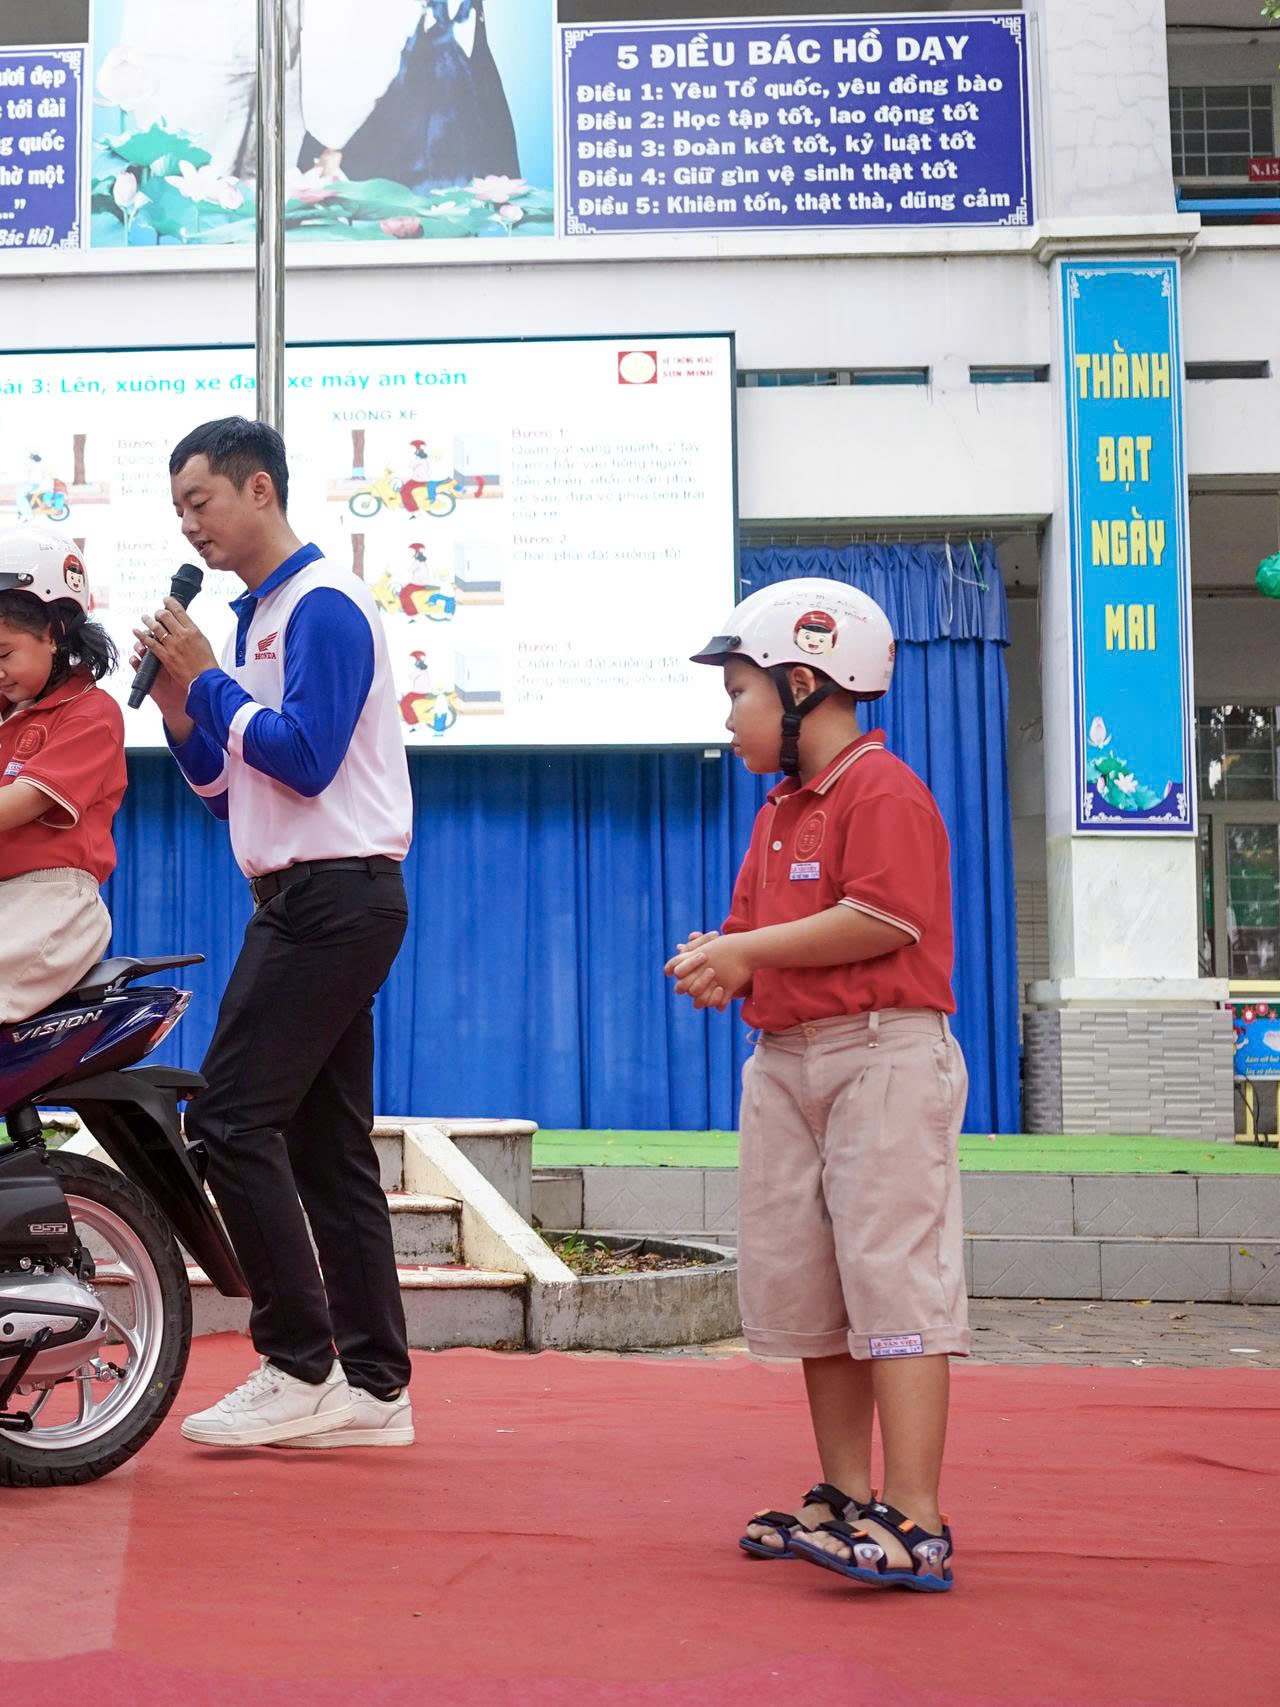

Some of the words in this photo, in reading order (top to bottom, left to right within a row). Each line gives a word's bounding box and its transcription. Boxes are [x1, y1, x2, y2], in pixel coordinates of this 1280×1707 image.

[617, 45, 639, 69] 5
[650, 33, 734, 68] ĐIỀU
[749, 34, 820, 65] BÁC
[834, 28, 882, 62] HỒ
[897, 36, 968, 65] DẠY
[30, 65, 66, 89] đẹp
[576, 82, 631, 102] Điều
[641, 83, 663, 100] 1:
[671, 82, 716, 99] Yêu
[724, 77, 757, 97] Tổ
[765, 77, 829, 99] quốc,
[838, 78, 880, 98] yêu
[889, 74, 948, 95] đồng
[958, 75, 1002, 91] bào
[7, 99, 32, 119] tới
[37, 98, 65, 118] đài
[577, 111, 632, 130] Điều
[640, 111, 664, 129] 2:
[674, 110, 720, 130] Học
[728, 109, 769, 129] tập
[777, 106, 821, 127] tốt,
[830, 107, 866, 123] lao
[874, 106, 934, 126] động
[943, 102, 978, 120] tốt
[19, 129, 64, 155] quốc
[577, 139, 632, 159] Điều
[641, 140, 665, 157] 3:
[673, 138, 735, 156] Đoàn
[745, 135, 785, 154] kết
[793, 134, 836, 155] tốt,
[846, 133, 873, 154] kỷ
[885, 134, 931, 154] luật
[939, 131, 975, 149] tốt
[28, 165, 64, 188] một
[577, 167, 632, 187] Điều
[641, 168, 665, 185] 4:
[674, 167, 715, 185] Giữ
[721, 166, 759, 186] gìn
[768, 165, 794, 185] vệ
[805, 164, 854, 181] sinh
[862, 163, 913, 183] thật
[921, 160, 957, 179] tốt
[578, 195, 628, 216] Điều
[636, 197, 659, 214] 5:
[667, 195, 736, 213] Khiêm
[743, 192, 787, 214] tốn,
[795, 193, 841, 213] thật
[848, 192, 892, 212] thà,
[901, 192, 955, 210] dũng
[964, 188, 1009, 207] cảm
[32, 378, 50, 394] 3:
[61, 376, 105, 395] Lên,
[195, 376, 221, 391] xe
[230, 374, 257, 393] đạ
[288, 374, 313, 389] xe
[322, 370, 370, 390] máy
[379, 373, 407, 387] an
[1076, 340, 1169, 399] THÀNH
[1096, 436, 1152, 491] ĐẠT
[1091, 506, 1166, 566] NGÀY
[1105, 604, 1155, 651] MAI
[255, 652, 277, 660] HONDA
[12, 1009, 103, 1043] VISION
